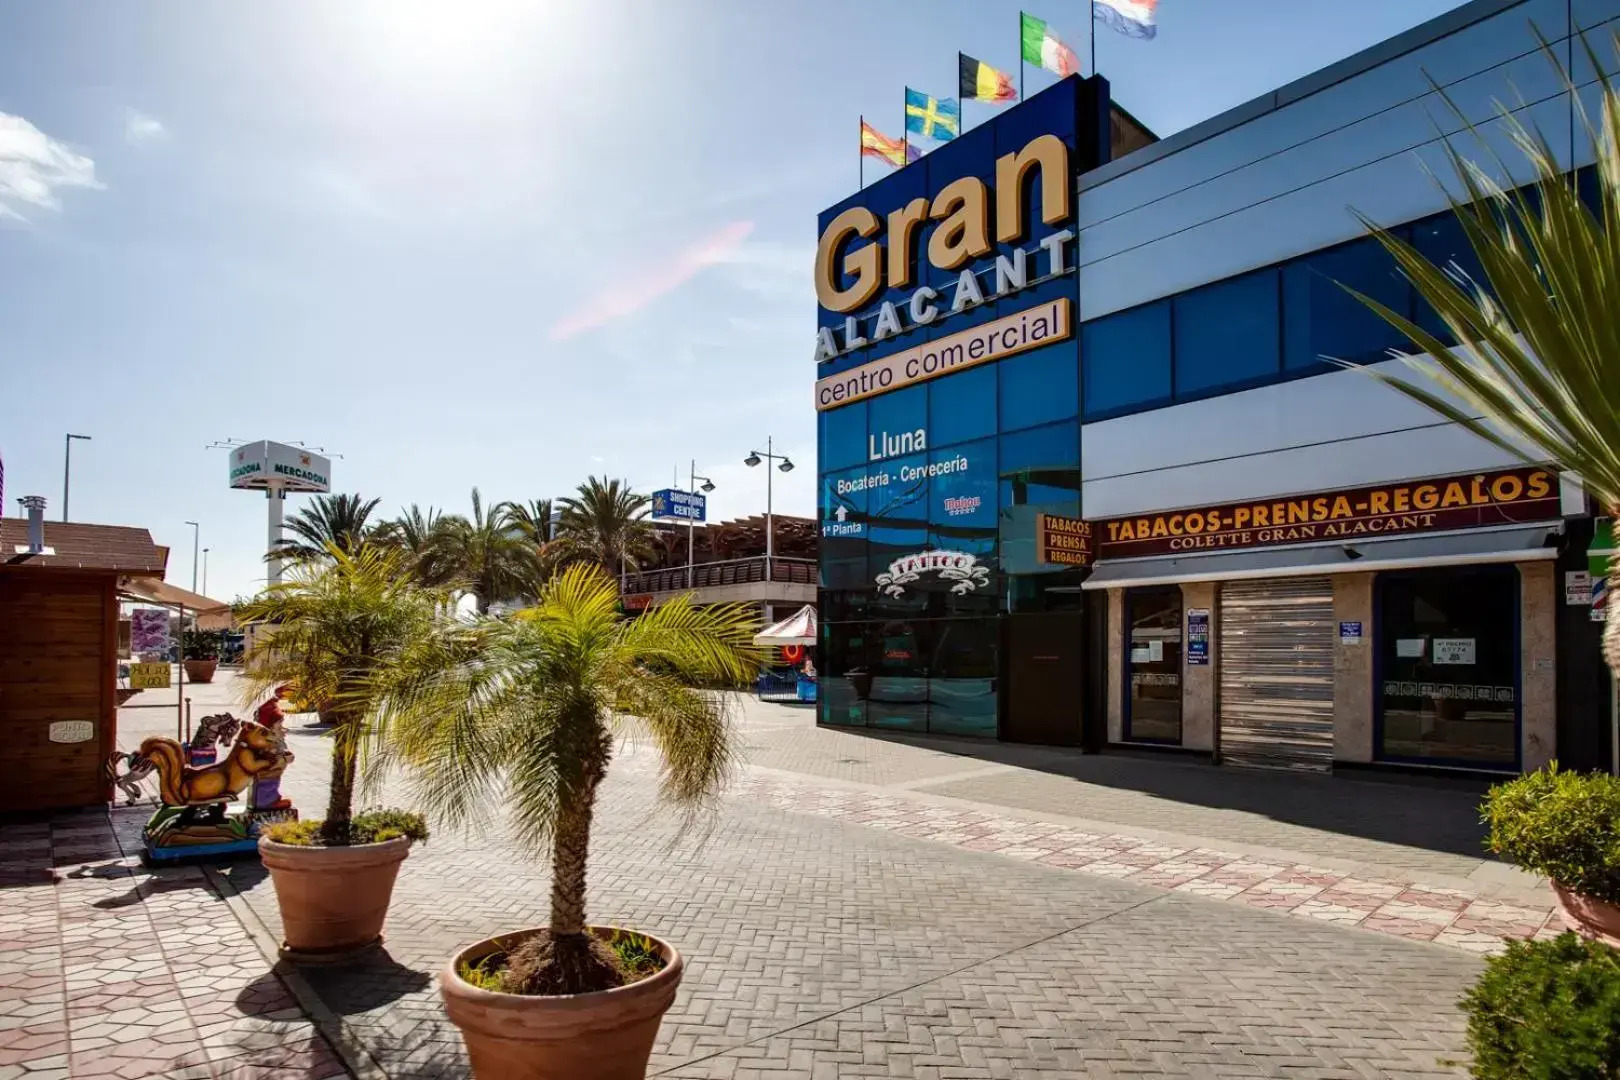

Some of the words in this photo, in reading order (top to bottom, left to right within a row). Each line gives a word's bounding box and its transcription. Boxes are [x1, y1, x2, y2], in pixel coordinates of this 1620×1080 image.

[815, 134, 1069, 312] Gran
[814, 229, 1076, 362] ALACANT
[820, 366, 893, 406] centro
[905, 304, 1058, 378] comercial
[869, 428, 926, 461] Lluna
[274, 463, 327, 485] MERCADONA
[1107, 471, 1549, 541] TABACOS-PRENSA-REGALOS
[832, 521, 862, 536] Planta
[1045, 516, 1090, 535] TABACOS
[1170, 532, 1251, 549] COLETTE
[1257, 524, 1316, 542] GRAN
[1324, 513, 1437, 536] ALACANT
[1050, 534, 1087, 550] PRENSA
[896, 555, 968, 574] TATTOO
[1051, 551, 1087, 565] REGALOS
